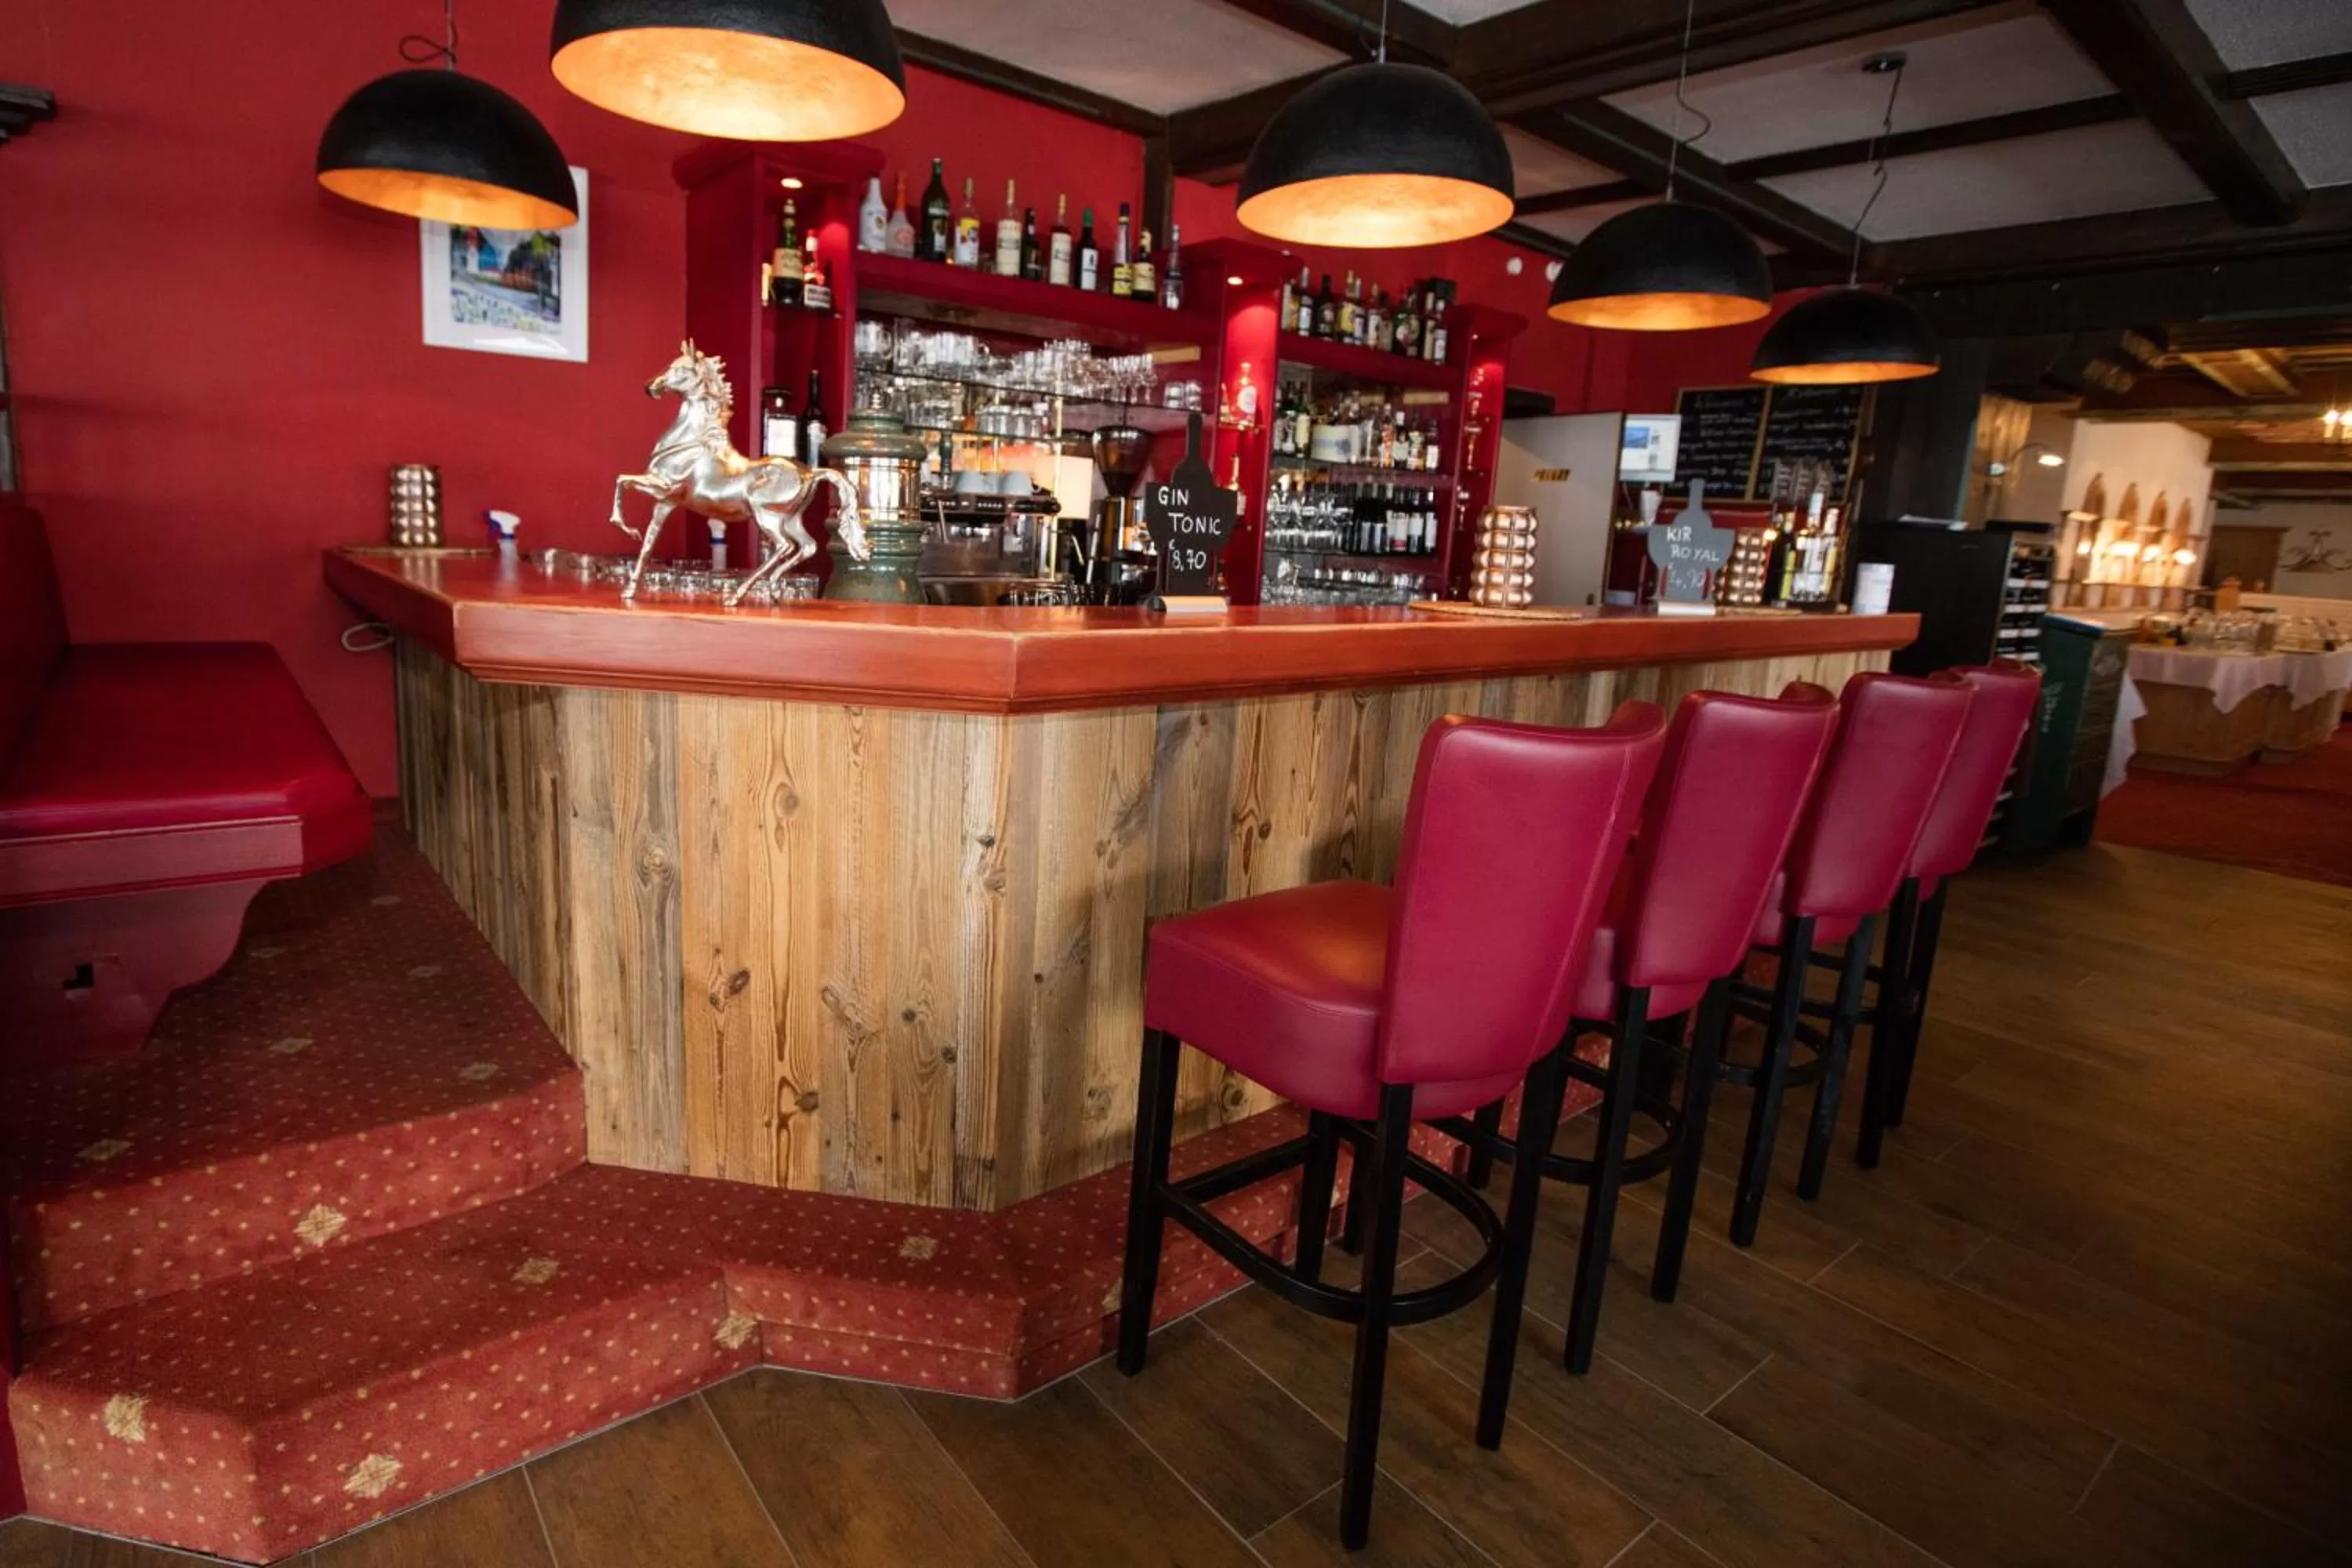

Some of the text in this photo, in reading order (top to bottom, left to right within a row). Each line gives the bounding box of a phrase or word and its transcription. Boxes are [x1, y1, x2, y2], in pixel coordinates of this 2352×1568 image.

[1158, 485, 1189, 506] GIN
[1167, 512, 1222, 535] TONIC
[1666, 525, 1692, 543] KIR
[1172, 550, 1207, 572] 8,70
[1670, 543, 1720, 562] ROYAL
